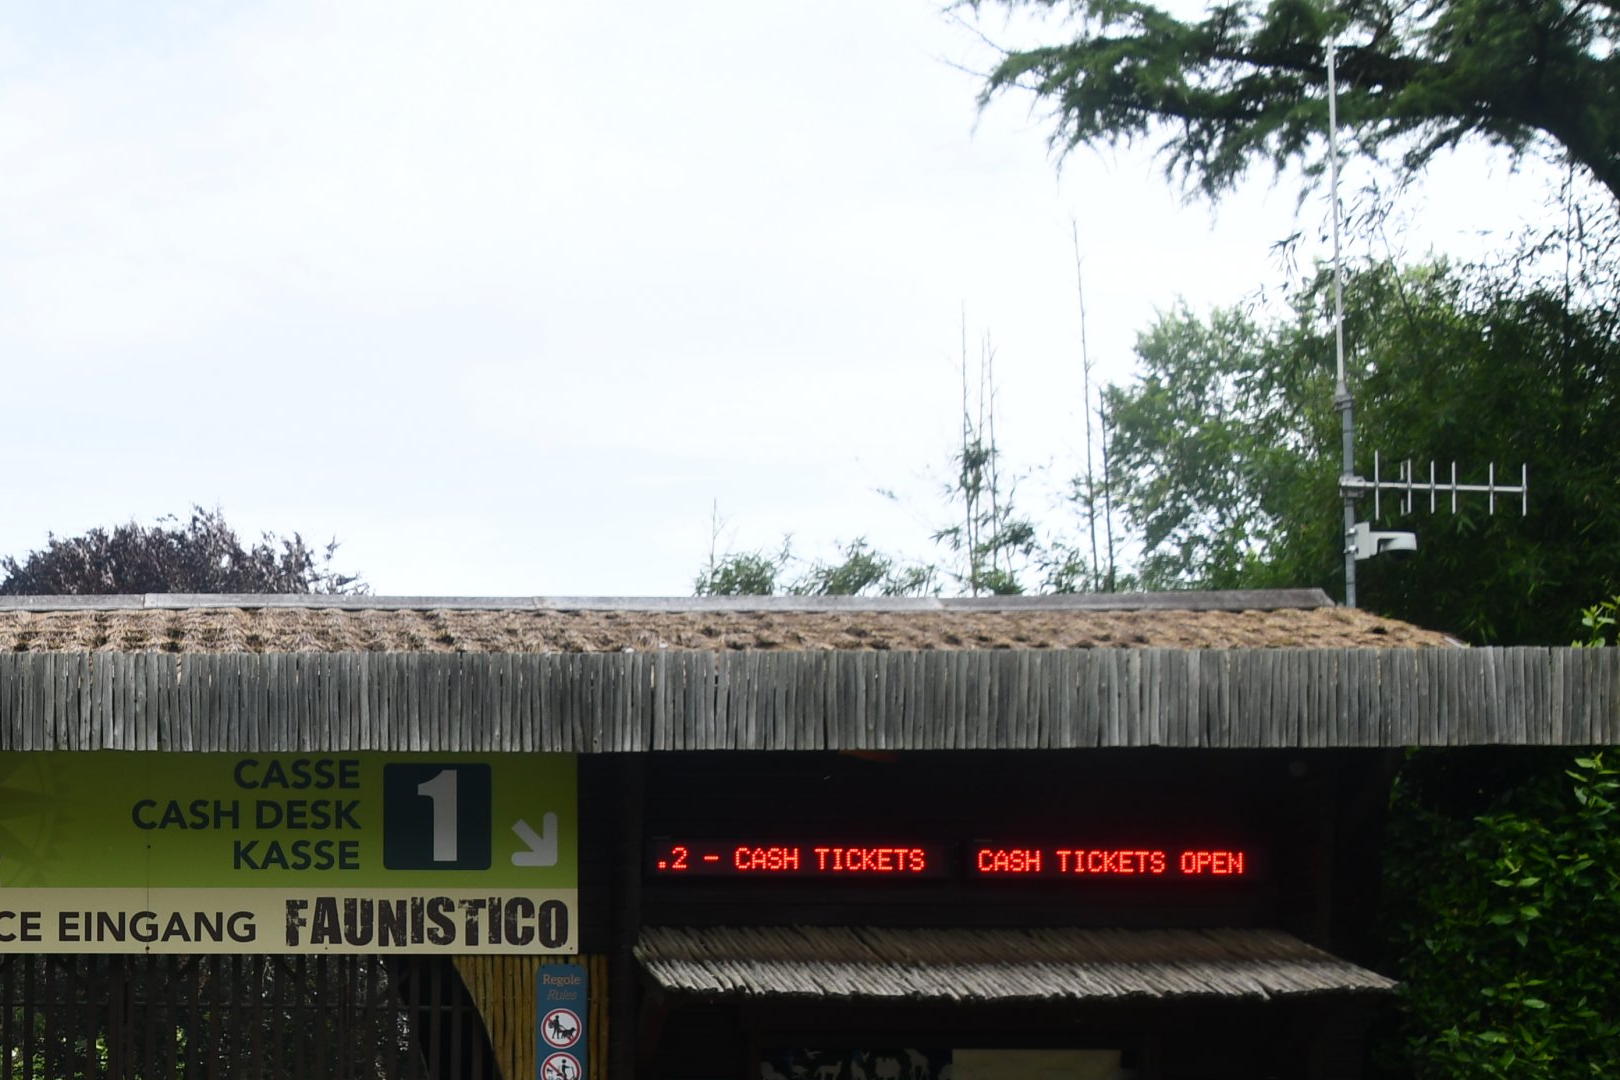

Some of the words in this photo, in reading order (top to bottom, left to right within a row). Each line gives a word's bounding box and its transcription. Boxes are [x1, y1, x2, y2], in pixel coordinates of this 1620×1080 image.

[234, 759, 360, 790] CASSE
[131, 799, 239, 830] CASH
[256, 800, 362, 830] DESK
[417, 769, 459, 862] 1
[233, 840, 360, 870] KASSE
[735, 848, 799, 870] CASH
[814, 848, 925, 871] TICKETS
[978, 850, 1041, 872] CASH
[1057, 851, 1165, 873] TICKETS
[1181, 852, 1243, 874] OPEN
[58, 911, 257, 943] EINGANG
[285, 897, 569, 949] FAUNISTICO
[542, 974, 581, 987] Regole
